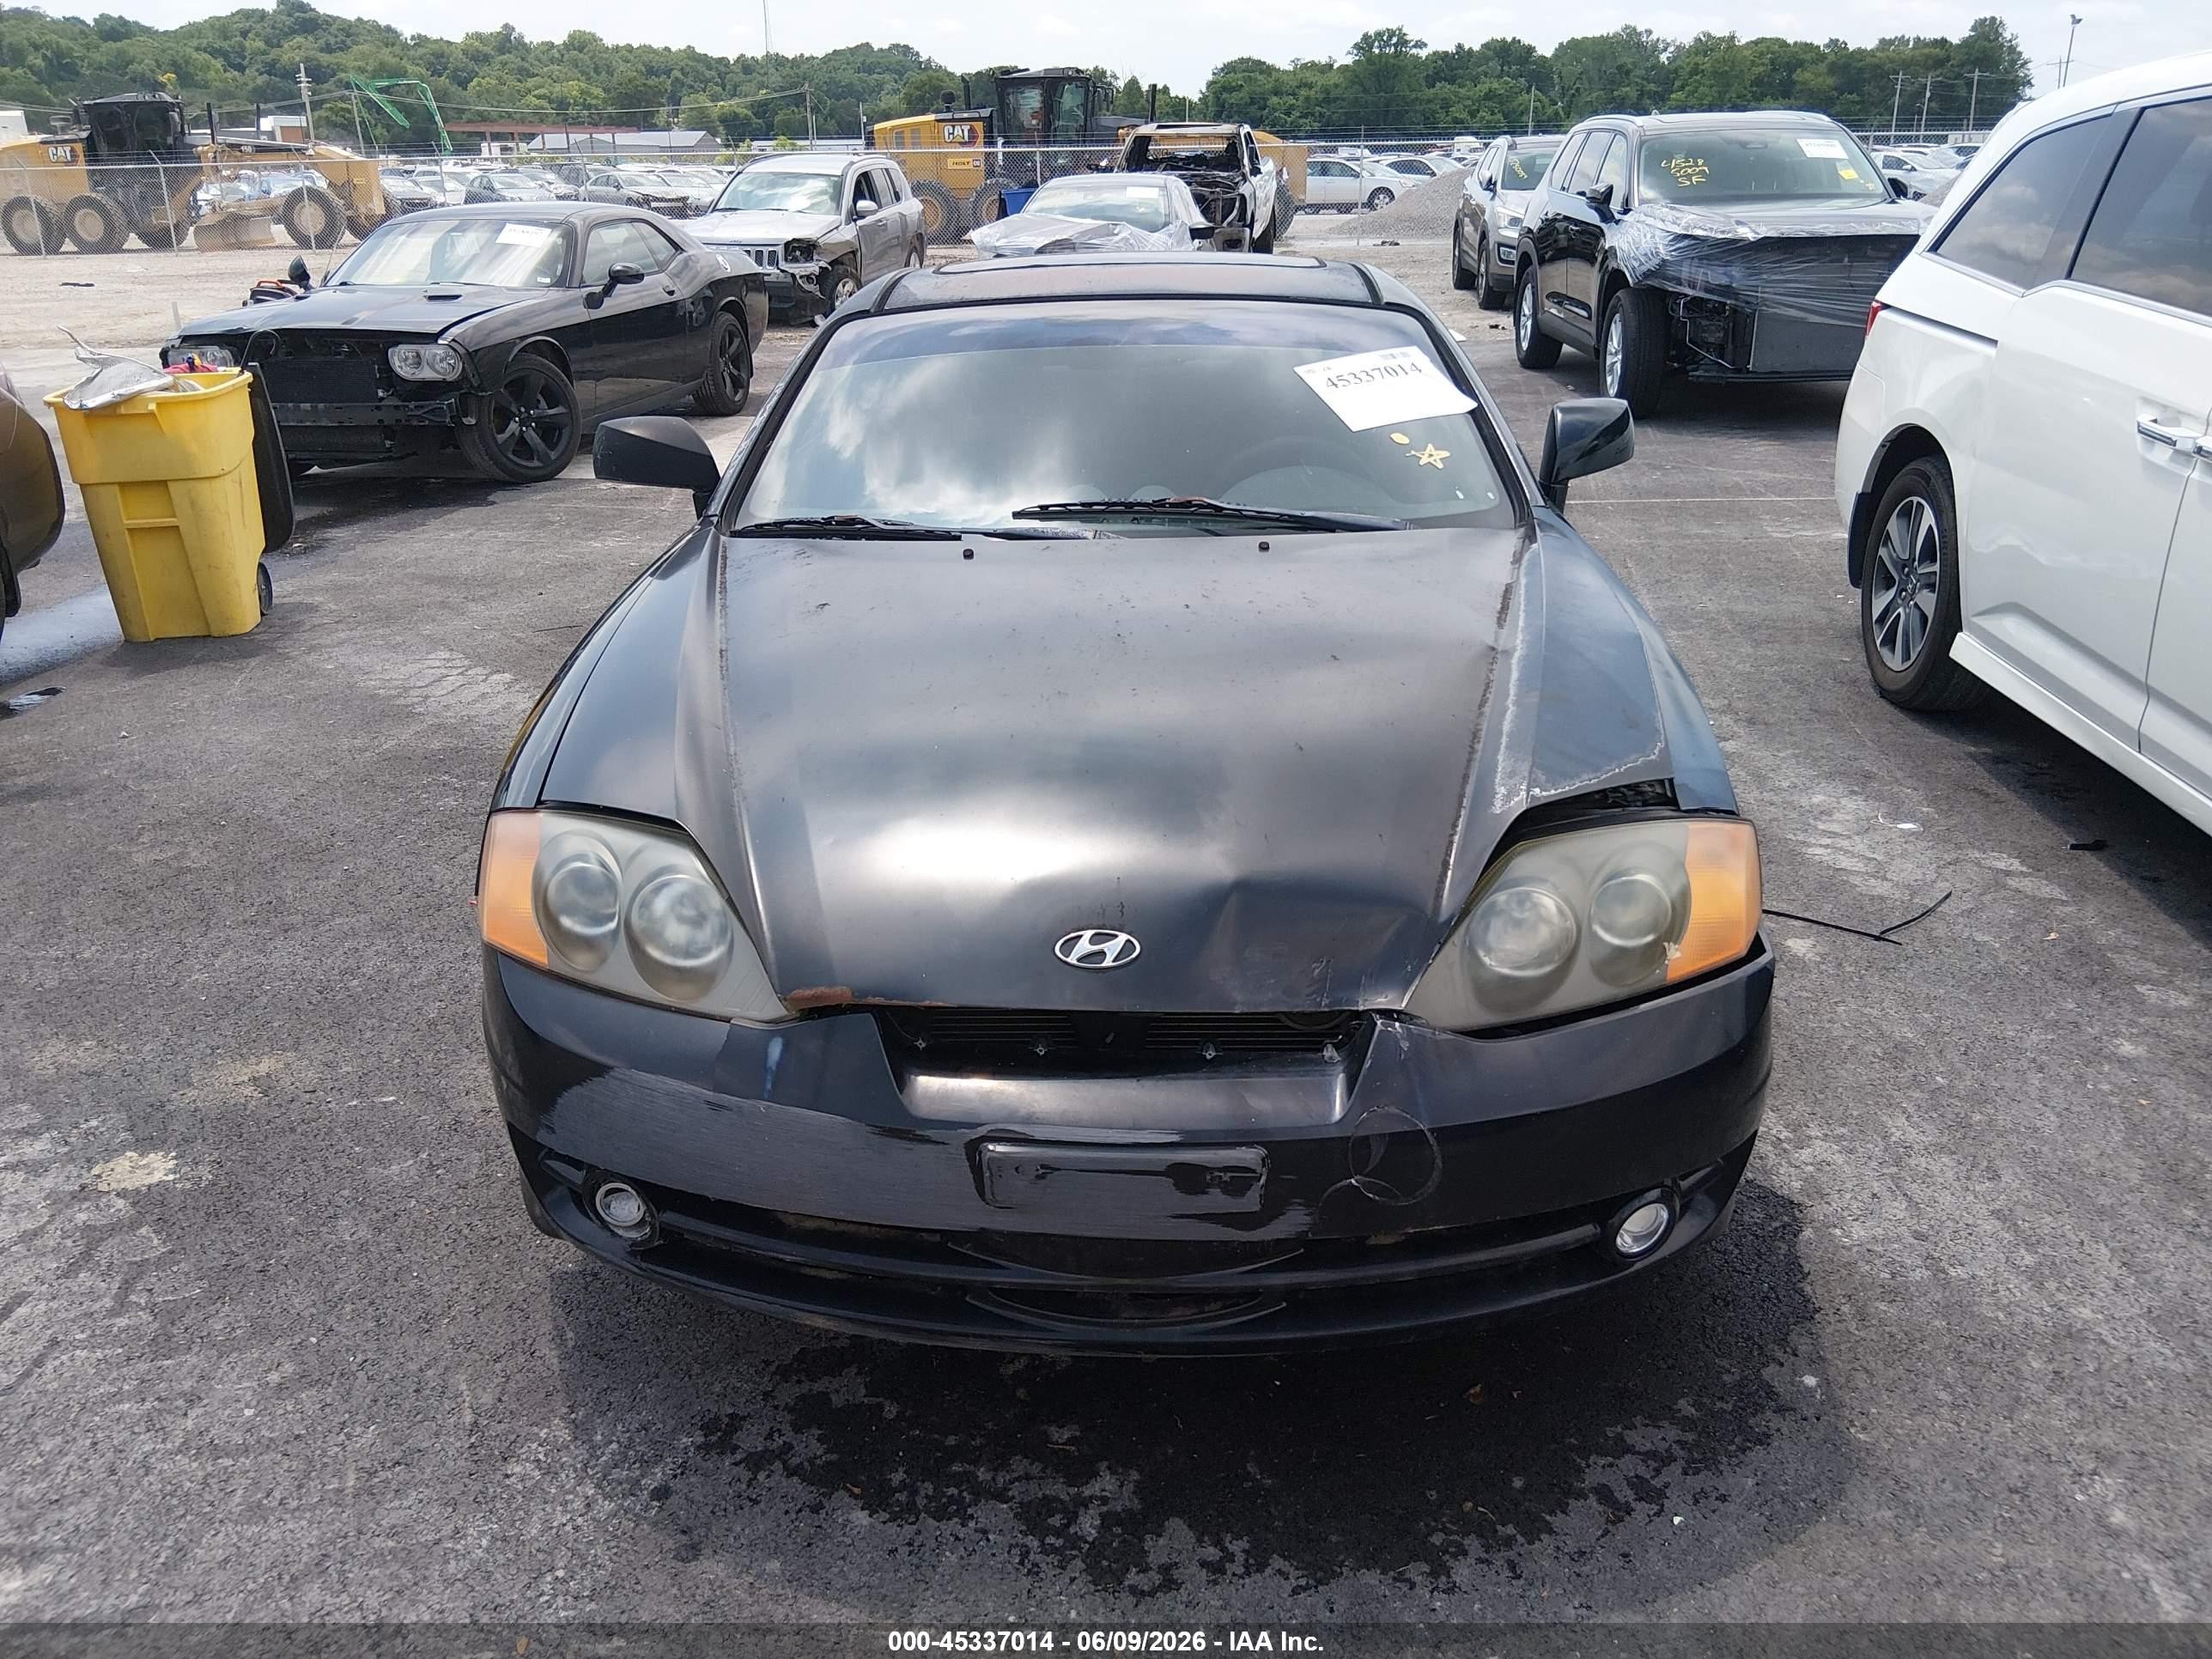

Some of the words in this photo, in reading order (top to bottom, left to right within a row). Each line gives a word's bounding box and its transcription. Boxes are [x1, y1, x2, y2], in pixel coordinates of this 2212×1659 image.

[944, 125, 970, 143] CAT
[48, 145, 72, 163] CAT
[1326, 362, 1422, 389] 45337014
